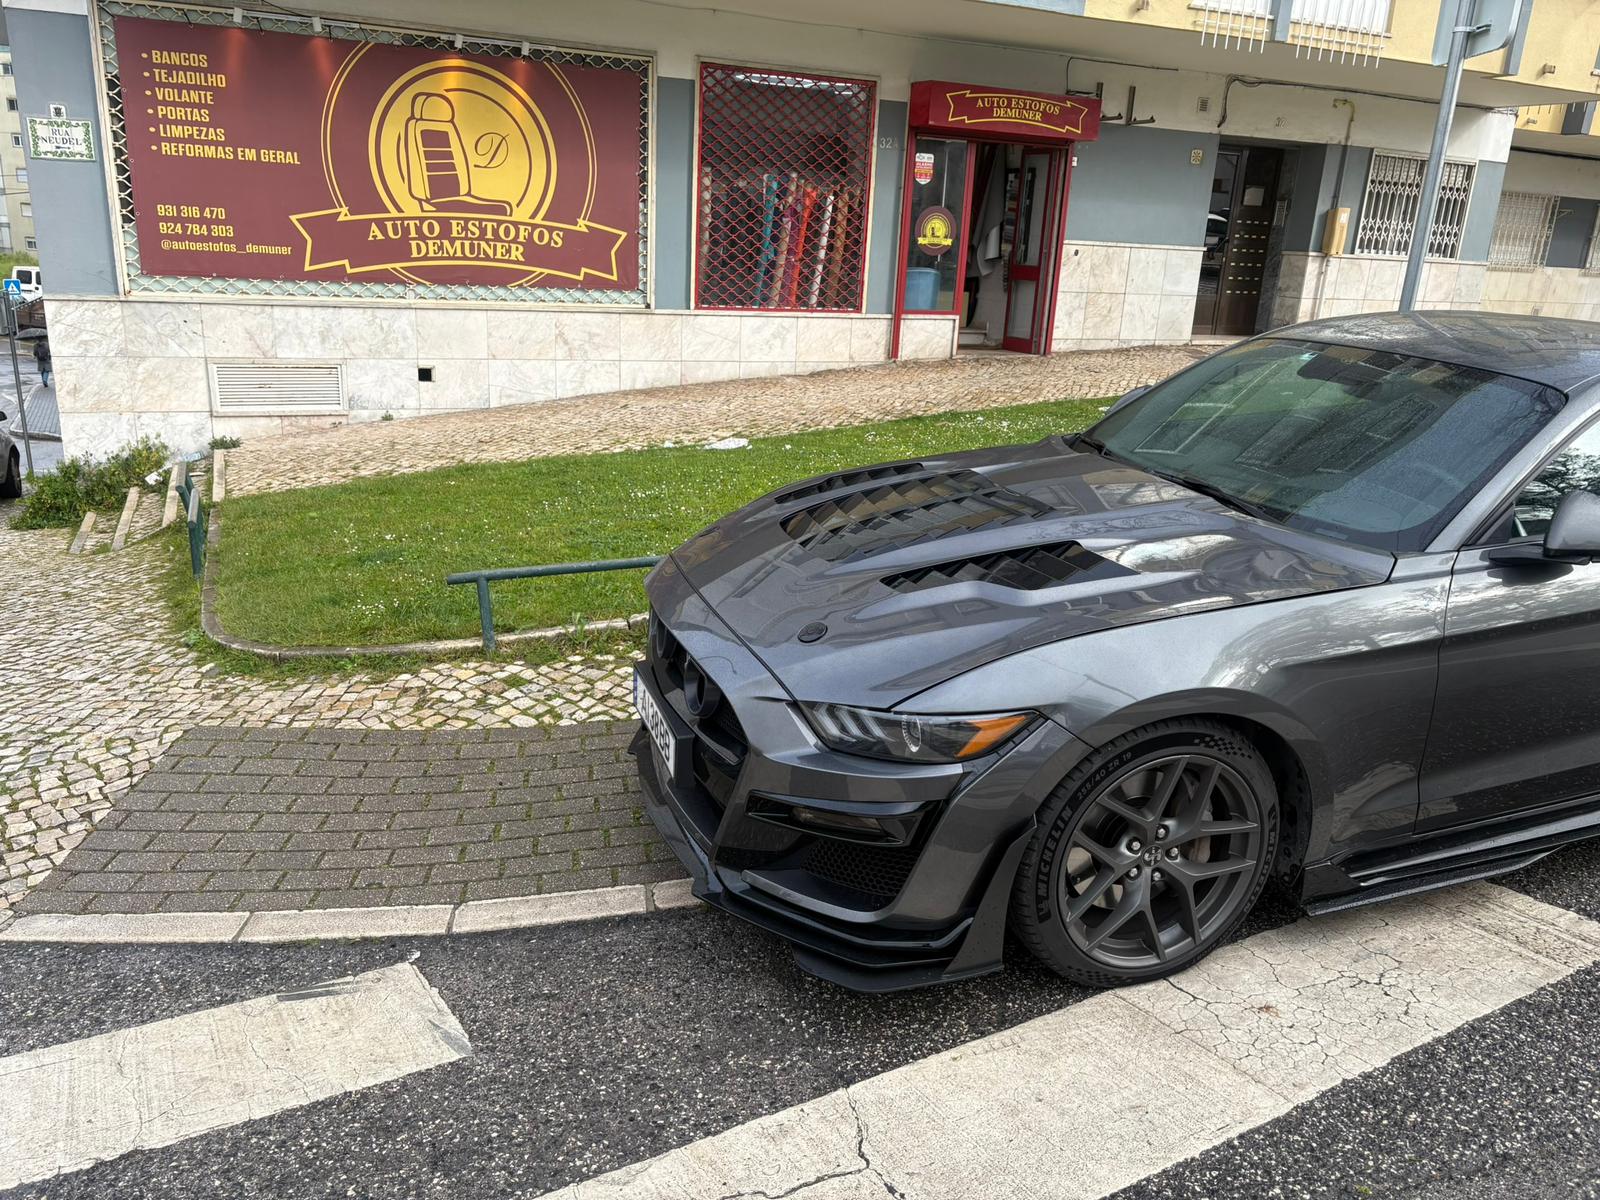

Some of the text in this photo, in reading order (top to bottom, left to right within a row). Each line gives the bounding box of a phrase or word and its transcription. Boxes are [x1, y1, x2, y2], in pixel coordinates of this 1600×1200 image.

[151, 50, 208, 68] BANCOS
[153, 68, 226, 88] TEJADILHO
[155, 87, 214, 105] VOLANTE
[157, 105, 210, 122] PORTAS
[976, 97, 1060, 115] AUTO ESTOFOS
[993, 108, 1042, 121] DEMUNER
[51, 128, 70, 137] RUA
[159, 123, 225, 141] LIMPEZAS
[160, 142, 301, 165] REFORMAS EM GERAL
[156, 204, 226, 219] 931 316 470
[159, 222, 234, 237] 924 784 303
[367, 219, 563, 248] AUTO ESTOFOS
[410, 240, 526, 263] DEMUNER
[1037, 806, 1074, 898] MICHELIN
